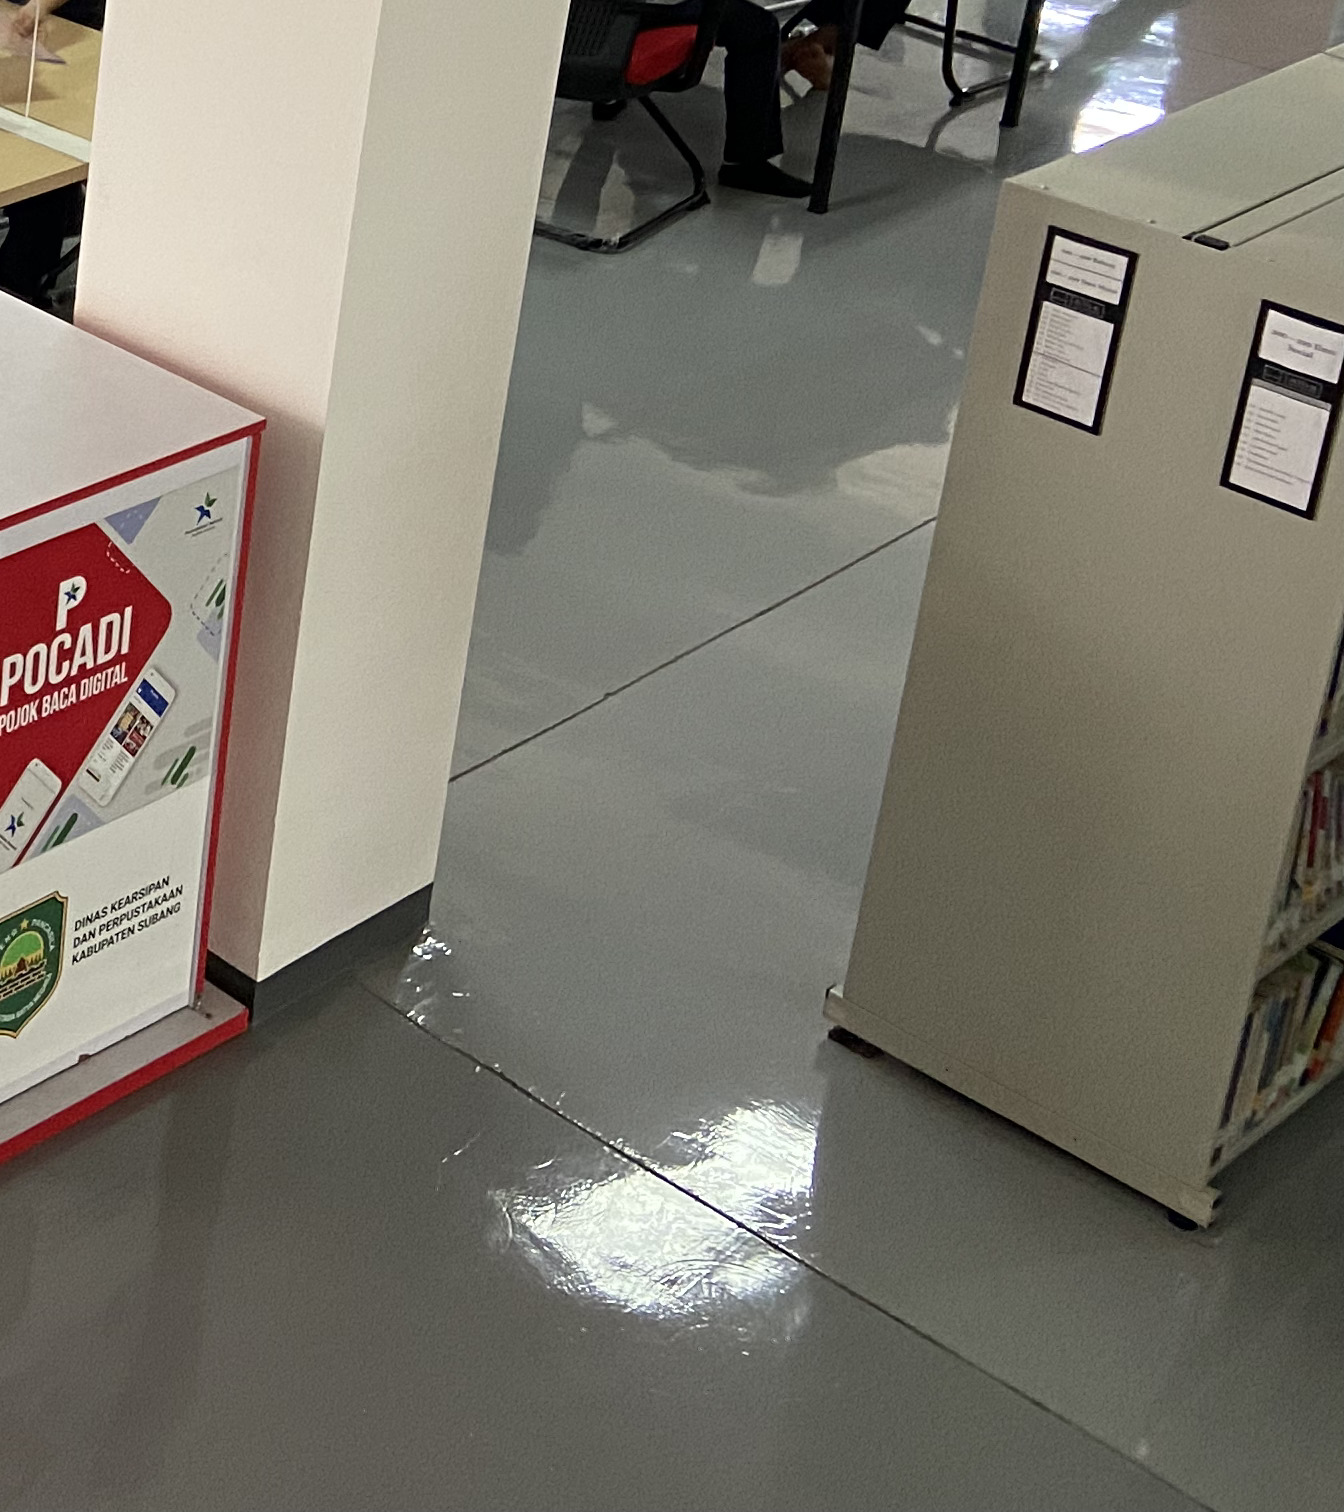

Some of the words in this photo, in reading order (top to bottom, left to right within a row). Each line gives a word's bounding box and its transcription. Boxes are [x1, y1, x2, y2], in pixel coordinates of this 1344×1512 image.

[0, 605, 133, 707] POCADI
[41, 683, 77, 718] BACA
[80, 661, 128, 701] DIGITAL
[72, 924, 135, 965] KABUPATEN
[137, 901, 181, 932] SUBANG
[73, 928, 96, 949] DAN
[98, 884, 183, 936] PERPUSTAKAAN
[74, 906, 108, 932] DINAS
[110, 875, 170, 913] KEARSIPAN
